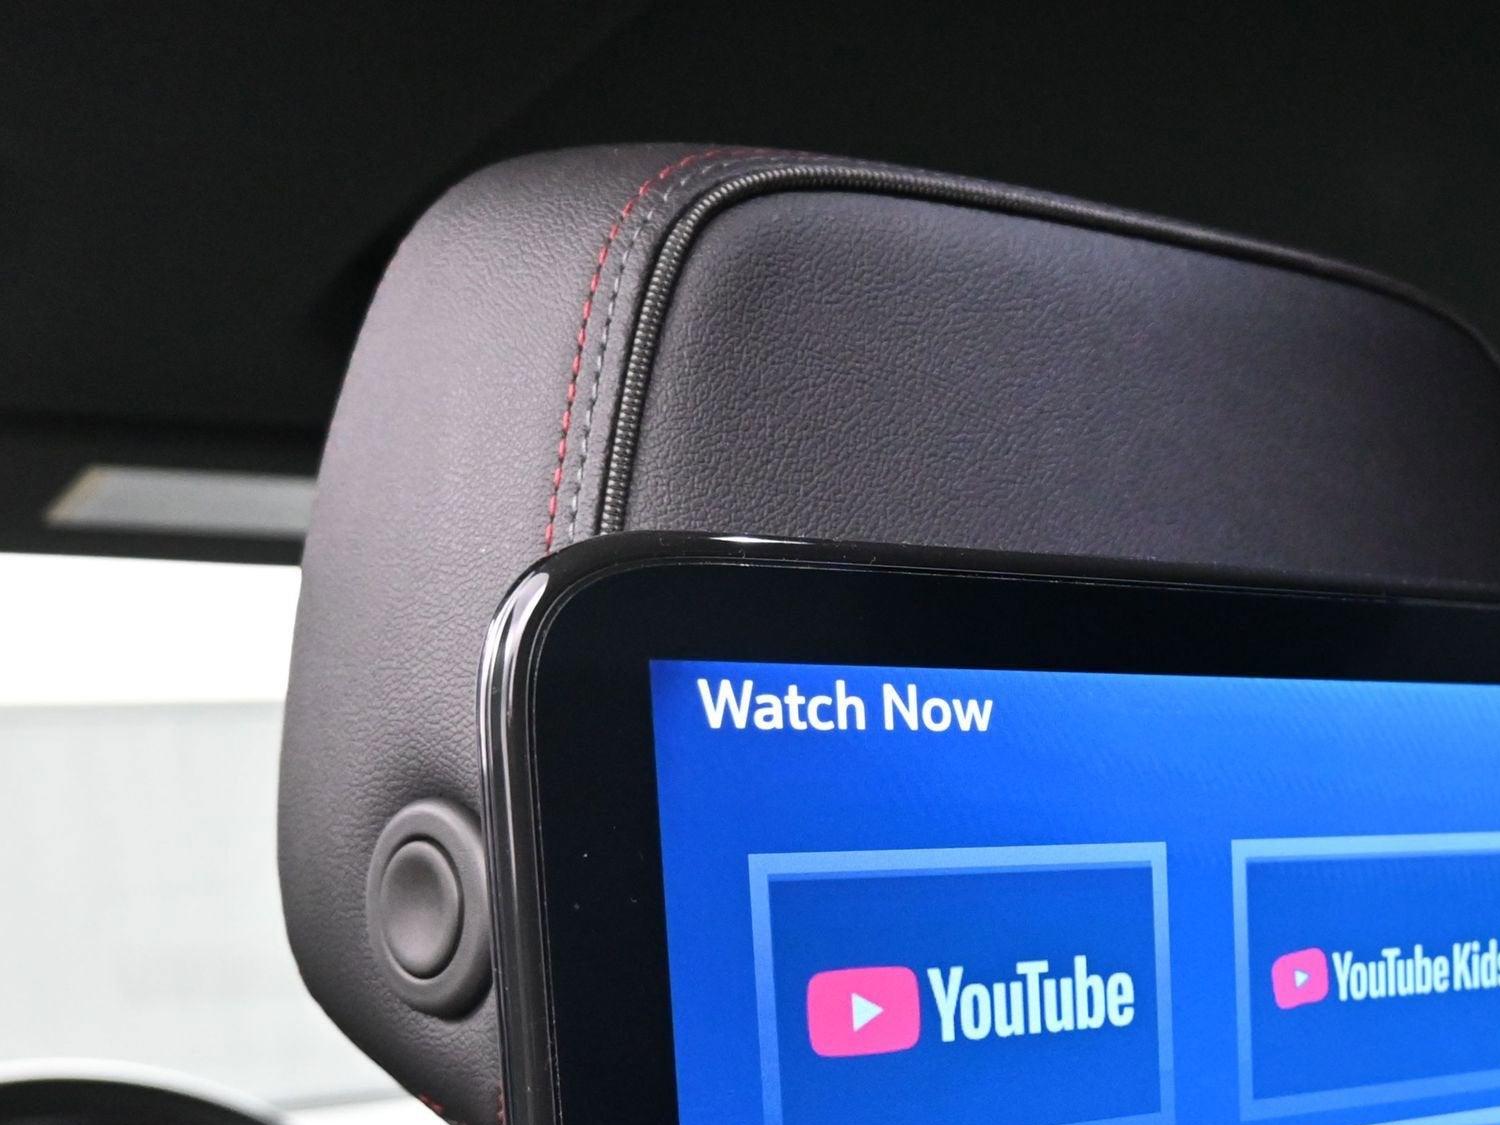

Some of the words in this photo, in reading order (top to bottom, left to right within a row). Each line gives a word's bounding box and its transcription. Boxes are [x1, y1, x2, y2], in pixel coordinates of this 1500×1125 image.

[697, 679, 866, 730] Watch
[883, 684, 993, 732] Now
[927, 954, 1135, 1043] YouTube
[1331, 944, 1449, 1002] YouTube
